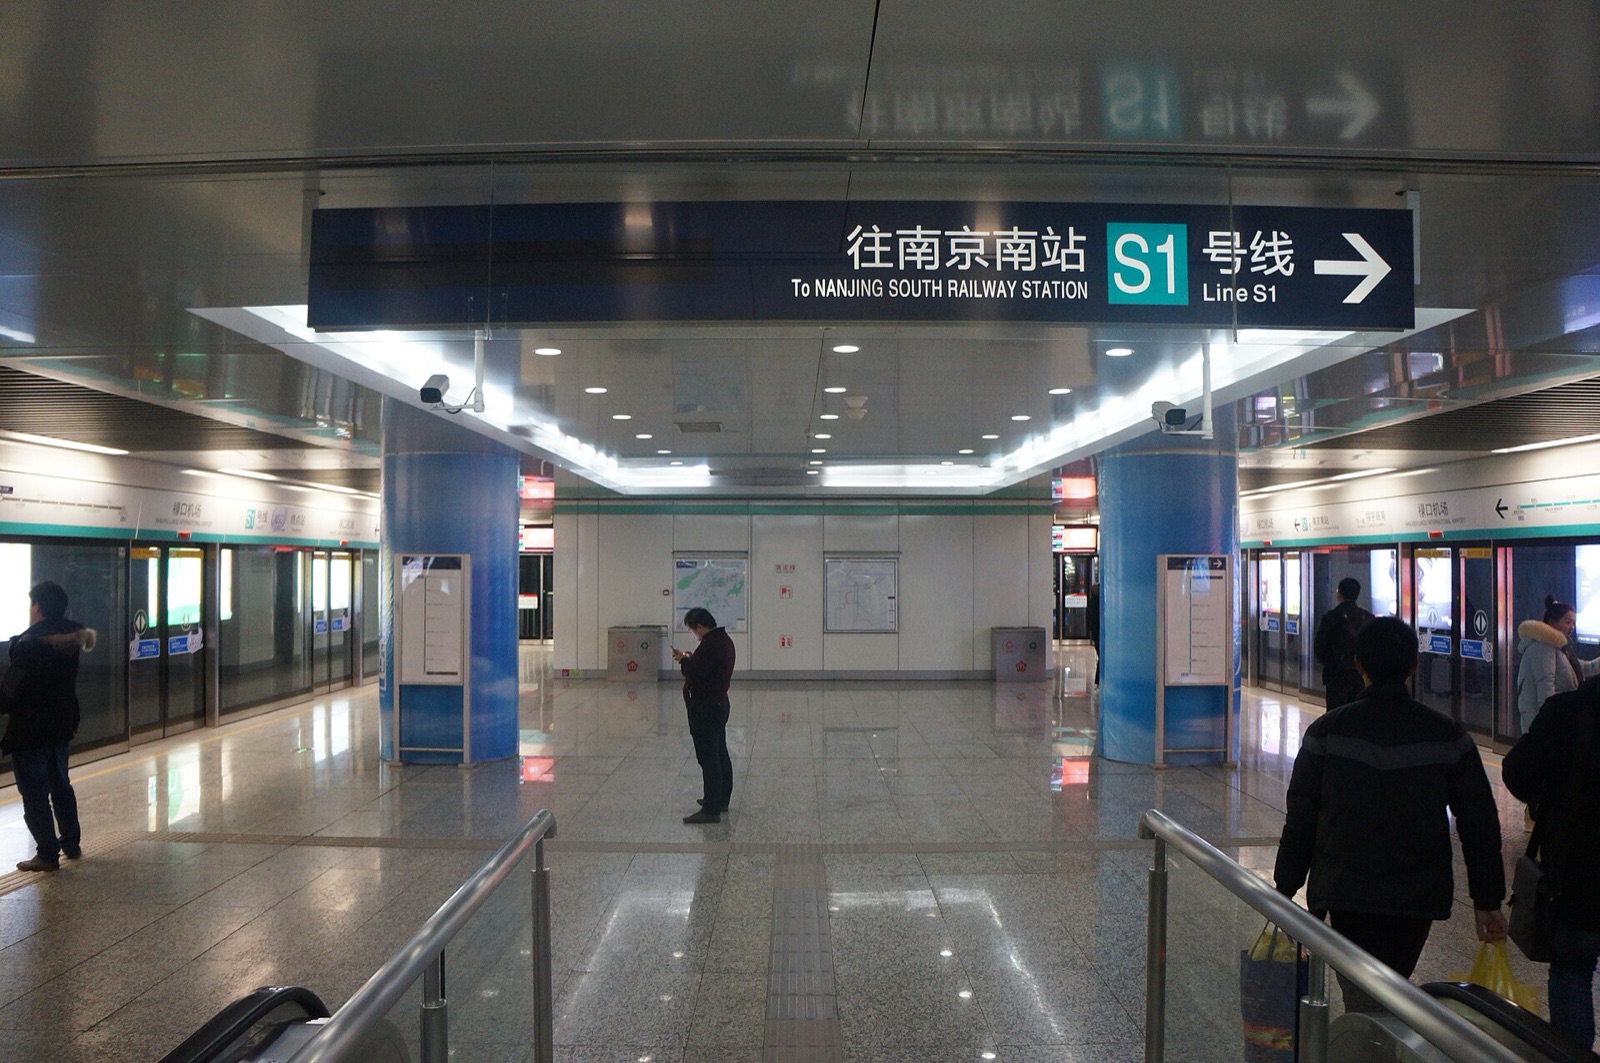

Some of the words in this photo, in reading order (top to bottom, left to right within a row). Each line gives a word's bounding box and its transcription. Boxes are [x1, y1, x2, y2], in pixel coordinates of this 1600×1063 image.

[847, 225, 1087, 273] 往南京南站
[1113, 233, 1175, 294] S1
[1203, 231, 1294, 276] 号线
[792, 279, 811, 298] To
[815, 279, 883, 297] NANJING
[888, 279, 942, 298] SOUTH
[947, 280, 1016, 299] RAILWAY
[1022, 281, 1088, 300] STATION
[1203, 283, 1248, 302] Line
[1253, 284, 1276, 303] S1
